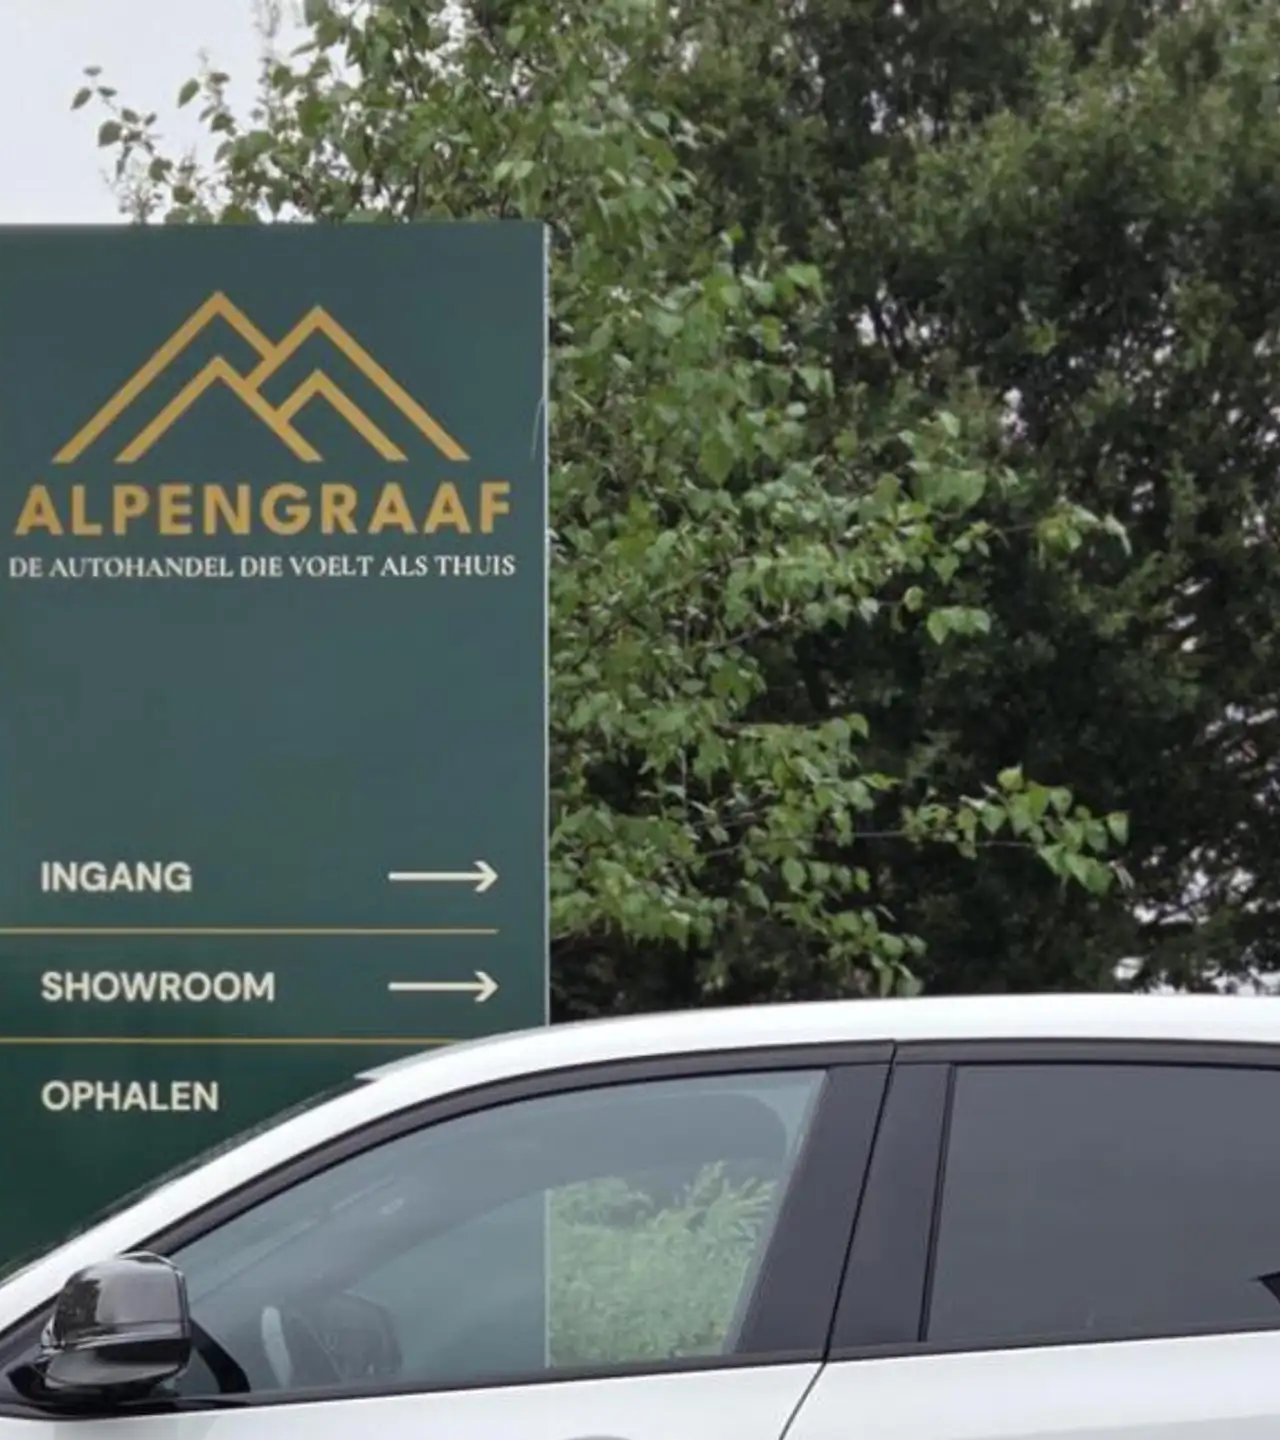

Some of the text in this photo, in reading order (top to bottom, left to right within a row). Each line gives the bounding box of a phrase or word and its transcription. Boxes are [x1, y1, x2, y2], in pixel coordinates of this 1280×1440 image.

[13, 480, 511, 536] ALPENGRAAF
[9, 553, 517, 578] DE AUTOHANDEL DIE VOELT ALS THUIS
[40, 861, 193, 892] INGANG
[40, 971, 276, 1002] SHOWROOM
[41, 1080, 219, 1111] OPHALEN
